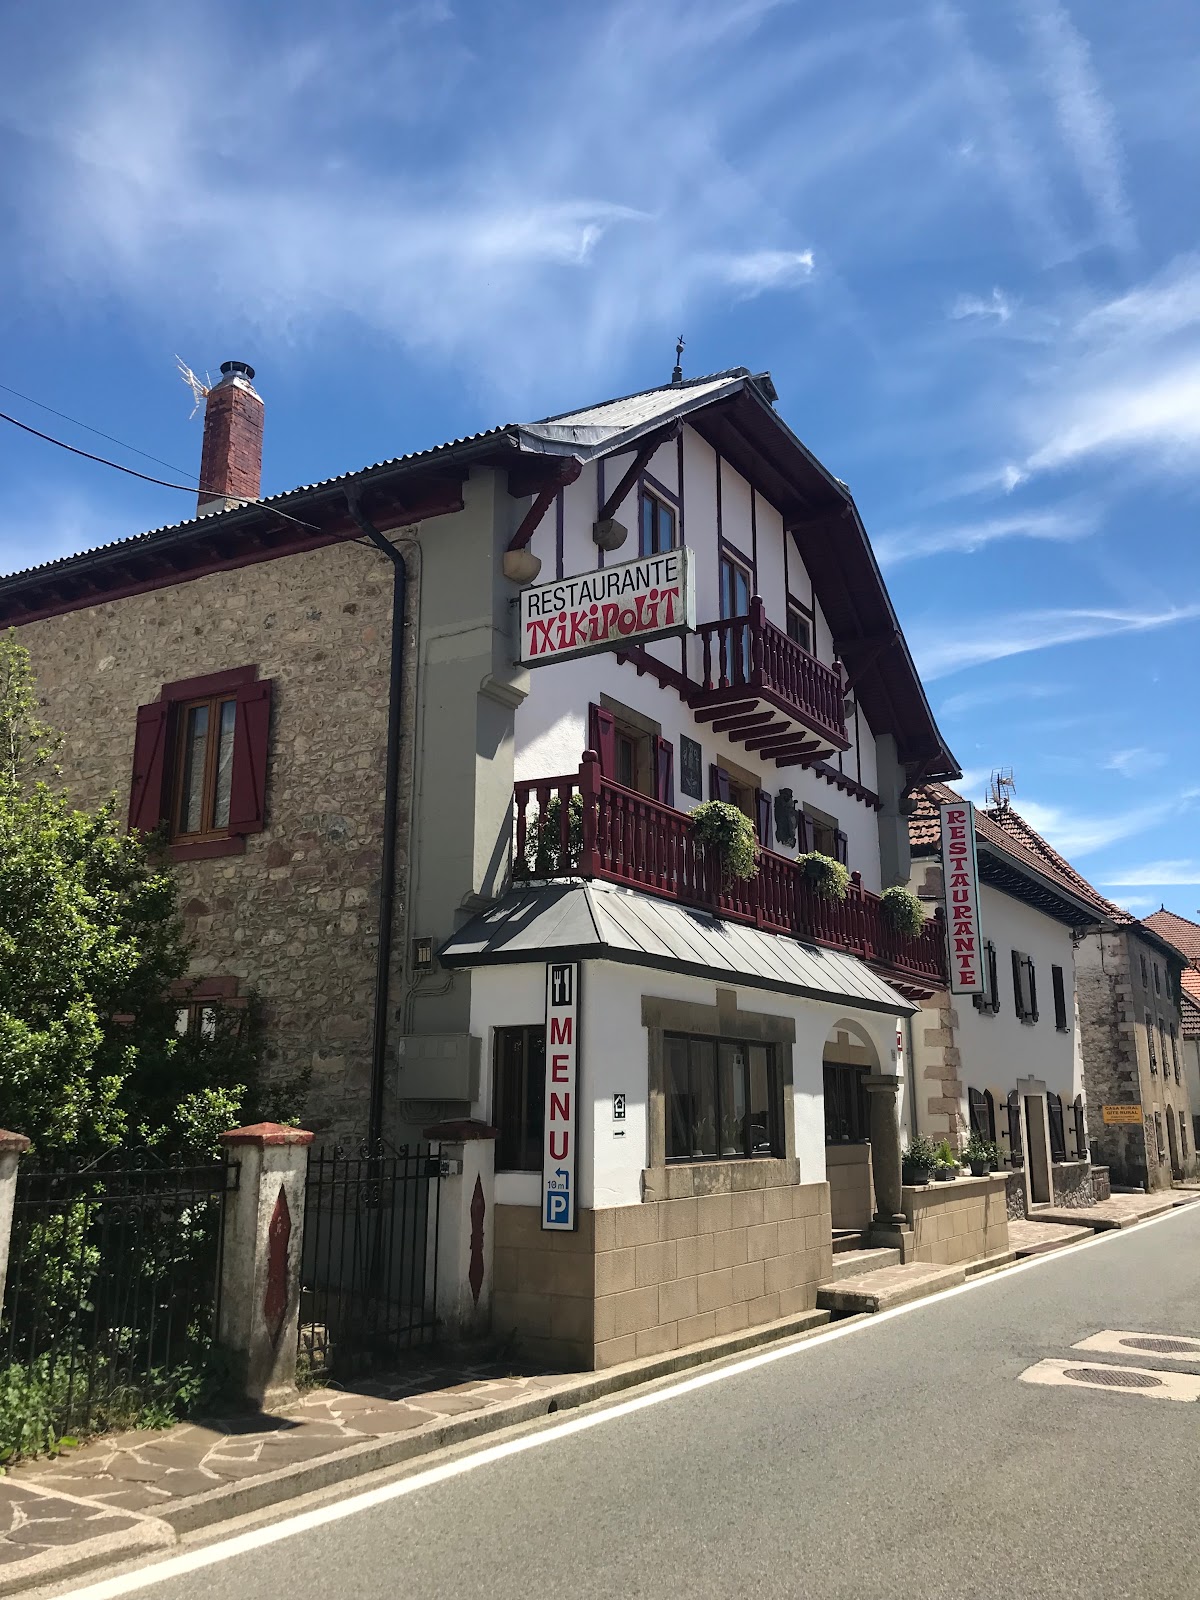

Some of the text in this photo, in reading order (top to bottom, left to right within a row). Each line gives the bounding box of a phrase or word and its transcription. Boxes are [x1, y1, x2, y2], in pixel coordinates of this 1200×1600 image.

[528, 556, 678, 618] RESTAURANTE
[946, 810, 976, 985] RESTAURANTE
[549, 1017, 573, 1161] MENU
[550, 1195, 567, 1221] P
